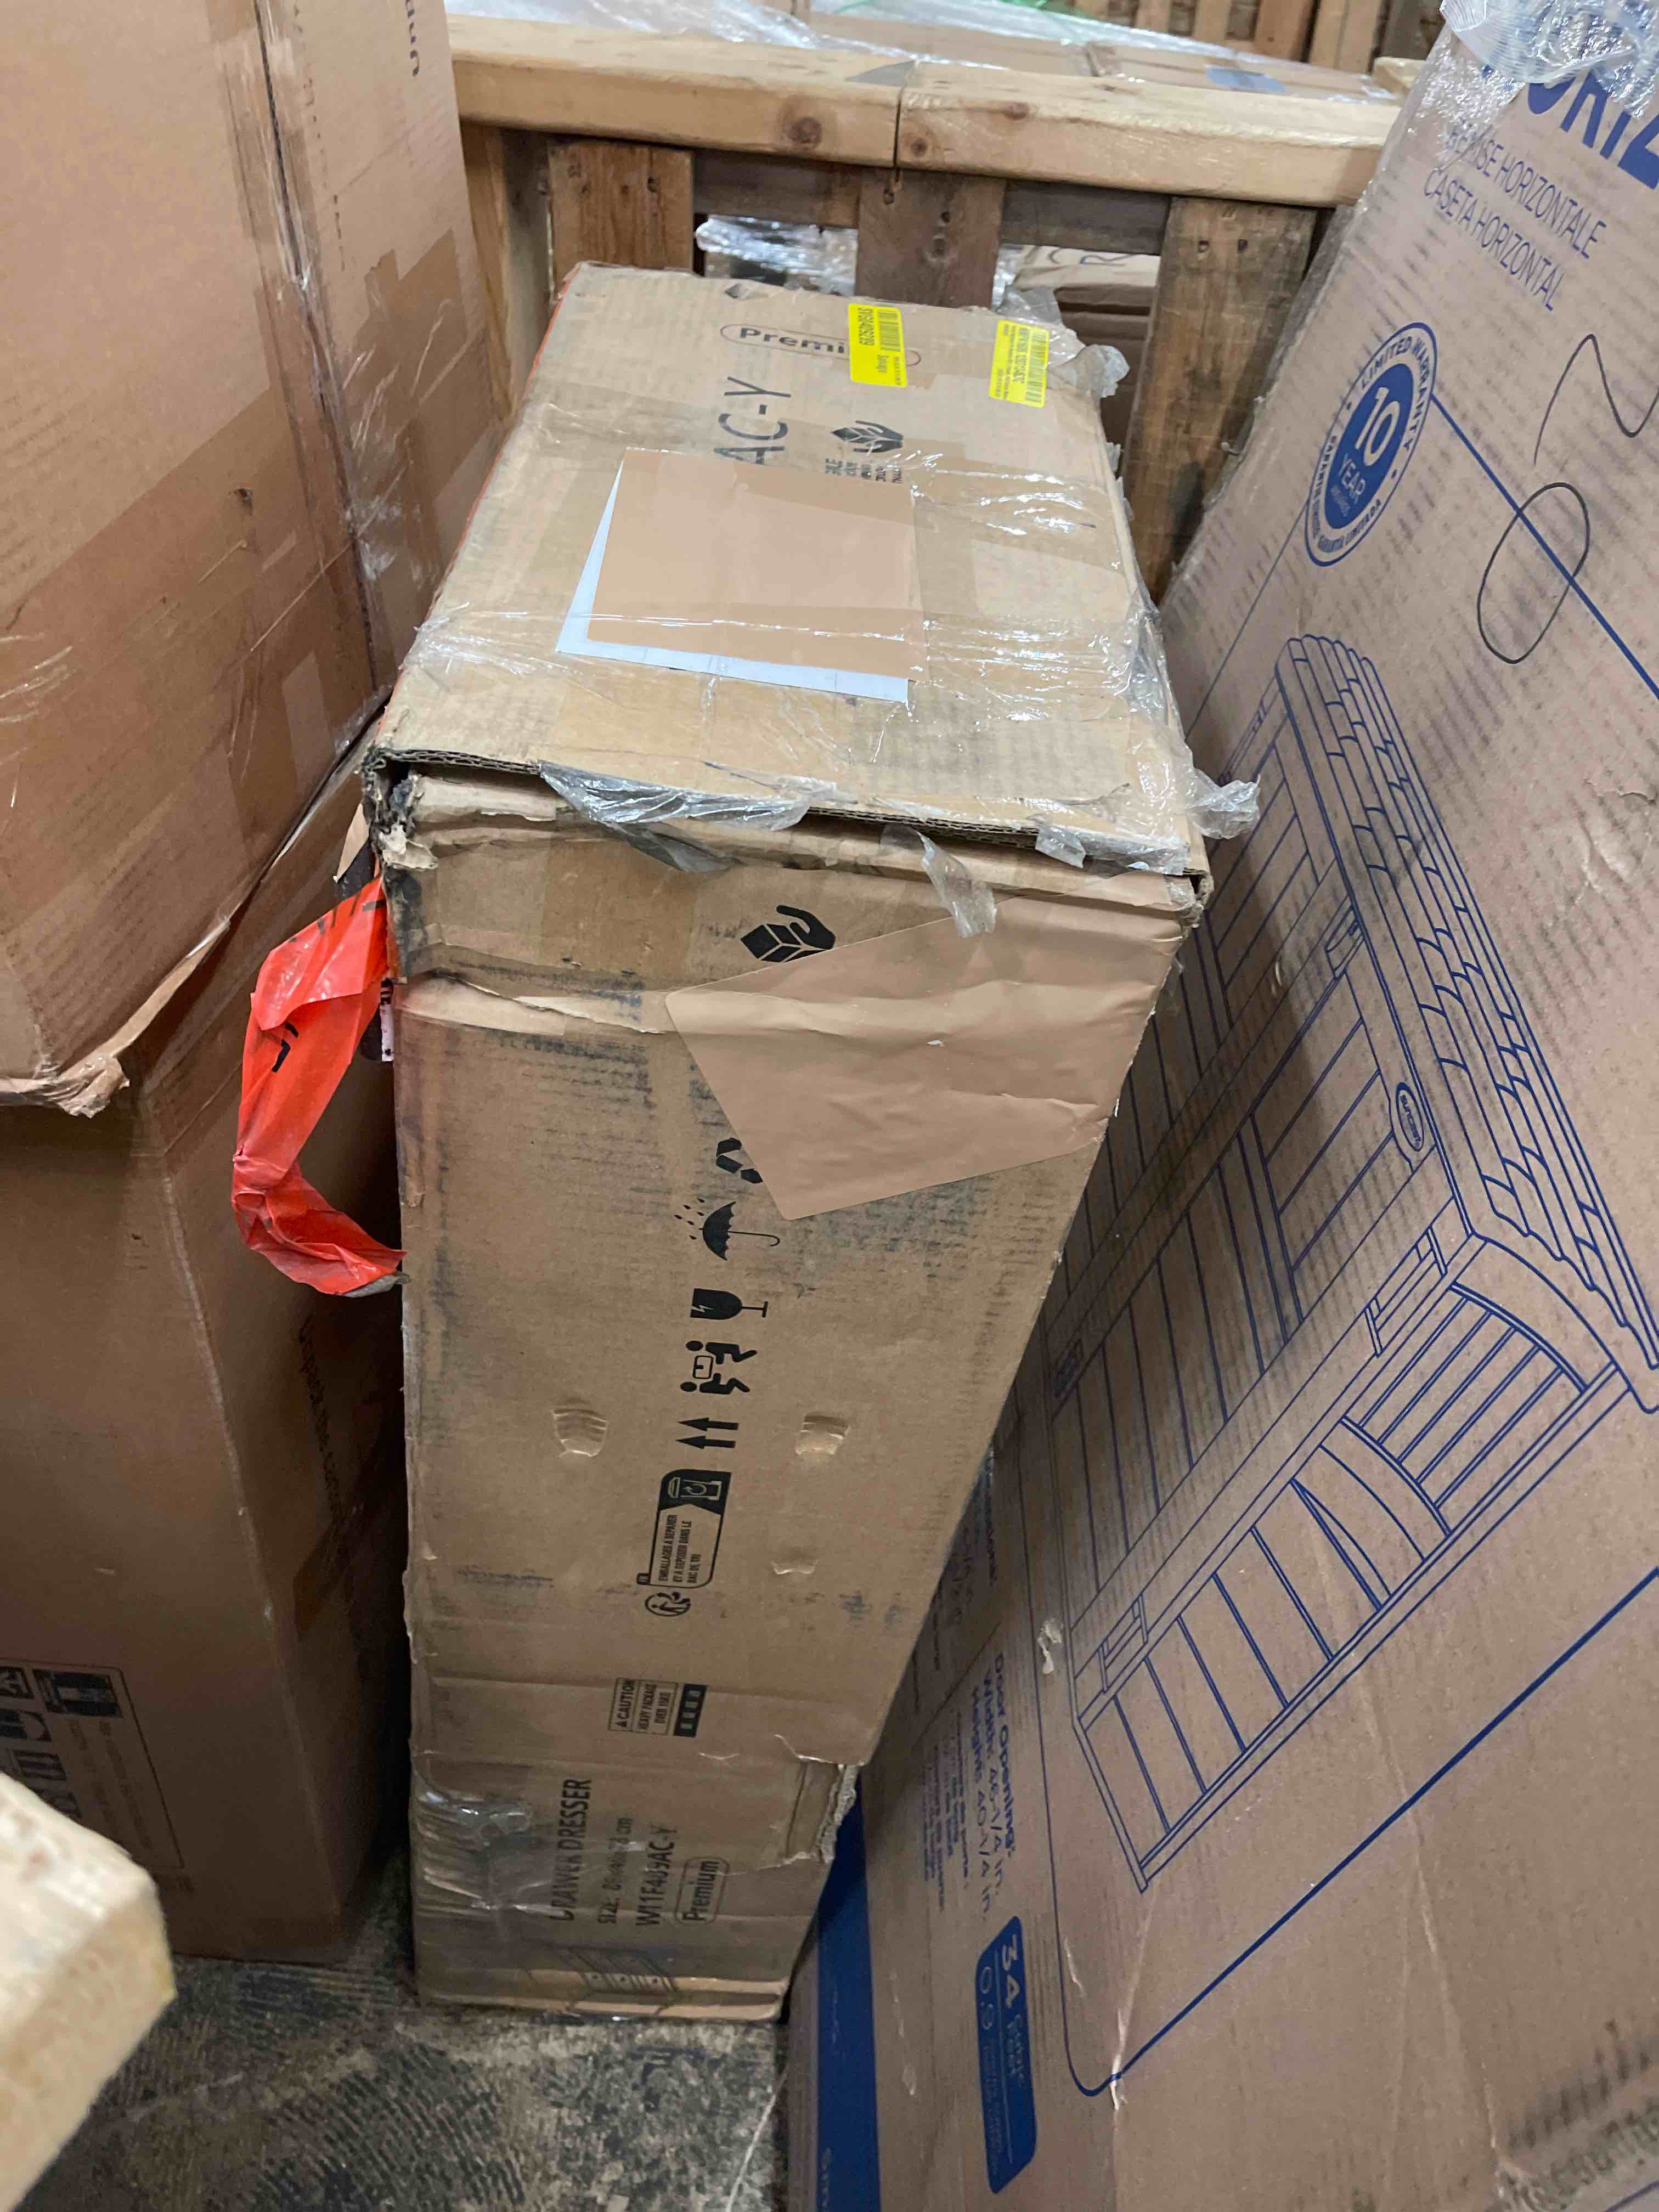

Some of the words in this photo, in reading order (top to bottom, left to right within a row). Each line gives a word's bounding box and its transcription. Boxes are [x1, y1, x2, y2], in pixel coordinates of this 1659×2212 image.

[1424, 167, 1478, 233] CASETA
[1470, 206, 1564, 312] HORIZONTAL
[1493, 152, 1606, 259] HORIZONTALE
[741, 328, 845, 354] Premi
[1354, 386, 1401, 467] 10
[618, 1680, 635, 1718] CAUTION
[557, 1779, 591, 1850] DRESSER
[682, 1860, 720, 1921] Premium
